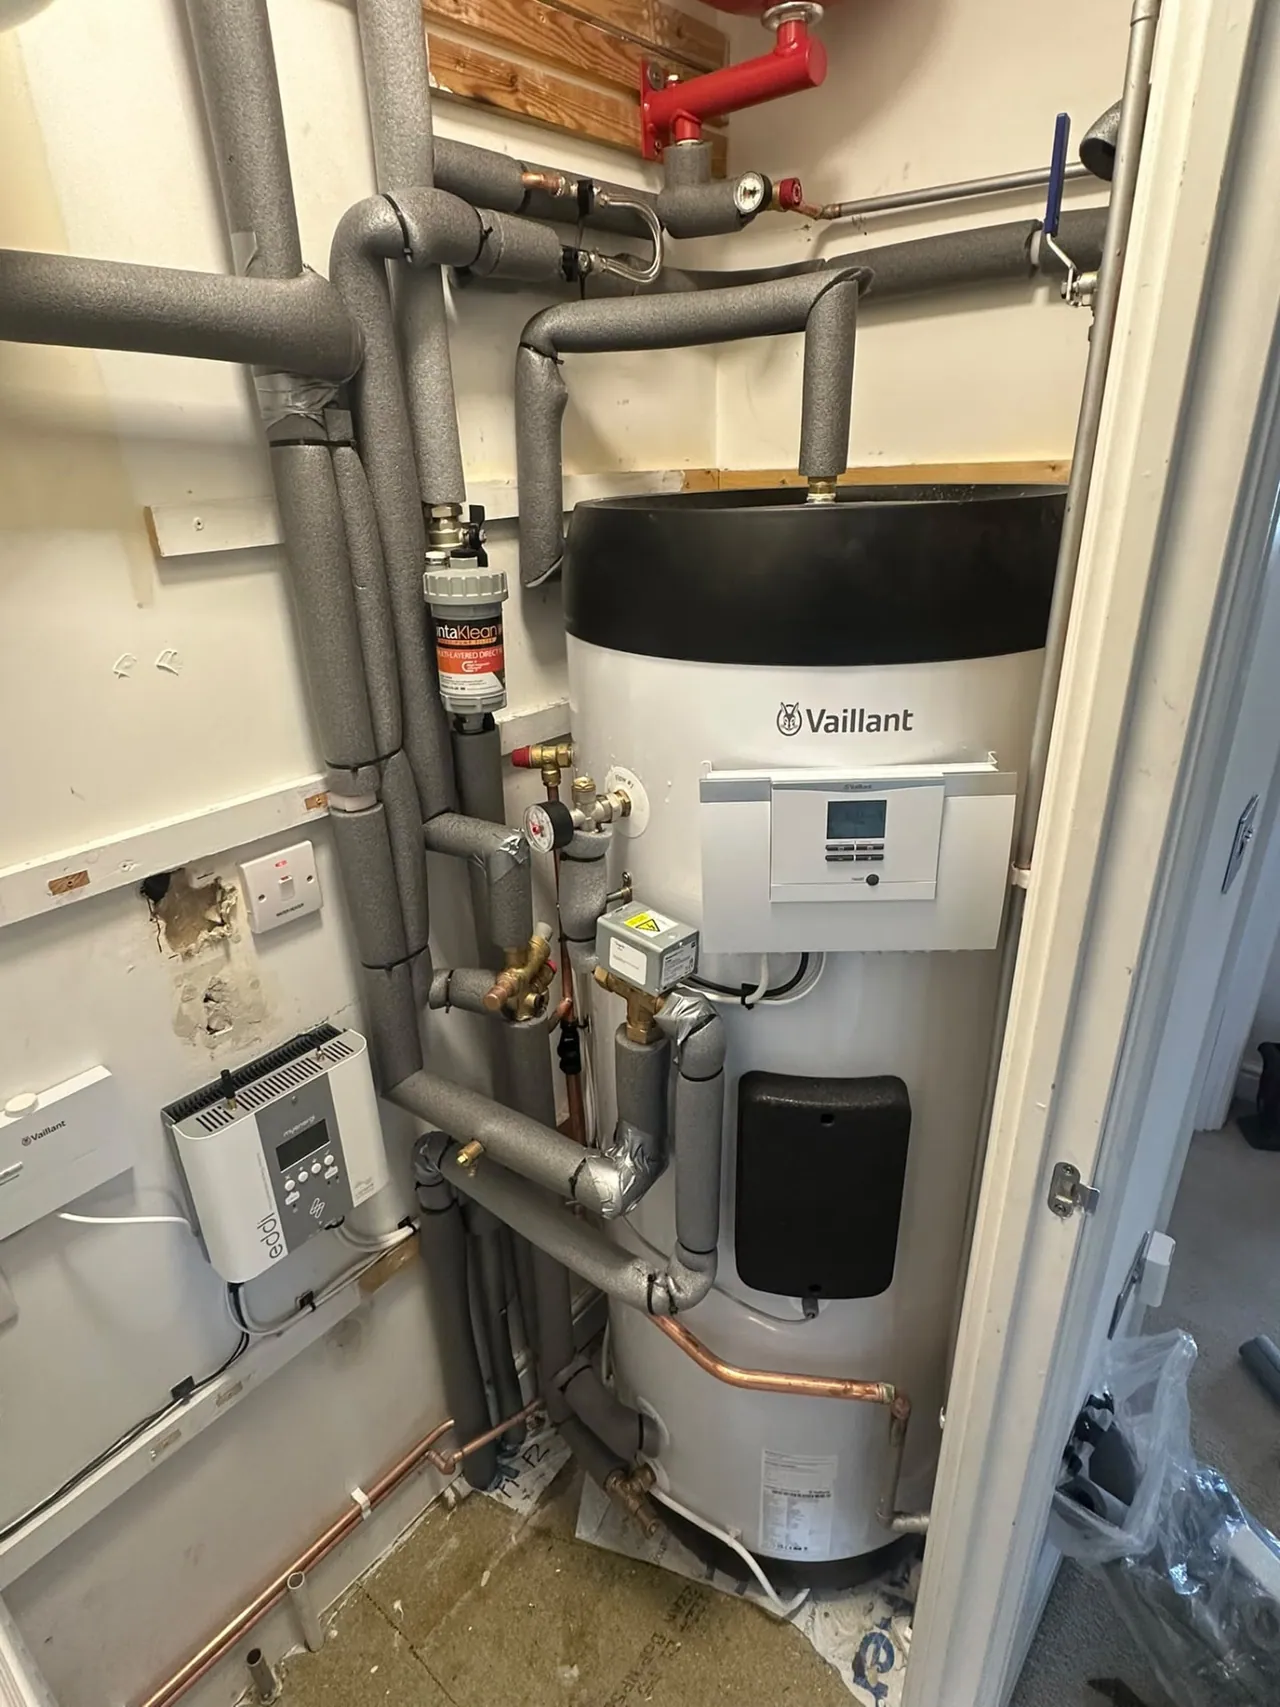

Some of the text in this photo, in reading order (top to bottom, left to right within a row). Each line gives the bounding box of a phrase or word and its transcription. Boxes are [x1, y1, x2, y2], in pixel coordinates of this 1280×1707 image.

[805, 708, 914, 733] Vaillant
[30, 1120, 66, 1141] Vaillant
[256, 1212, 283, 1258] eddi
[521, 1443, 550, 1468] F2
